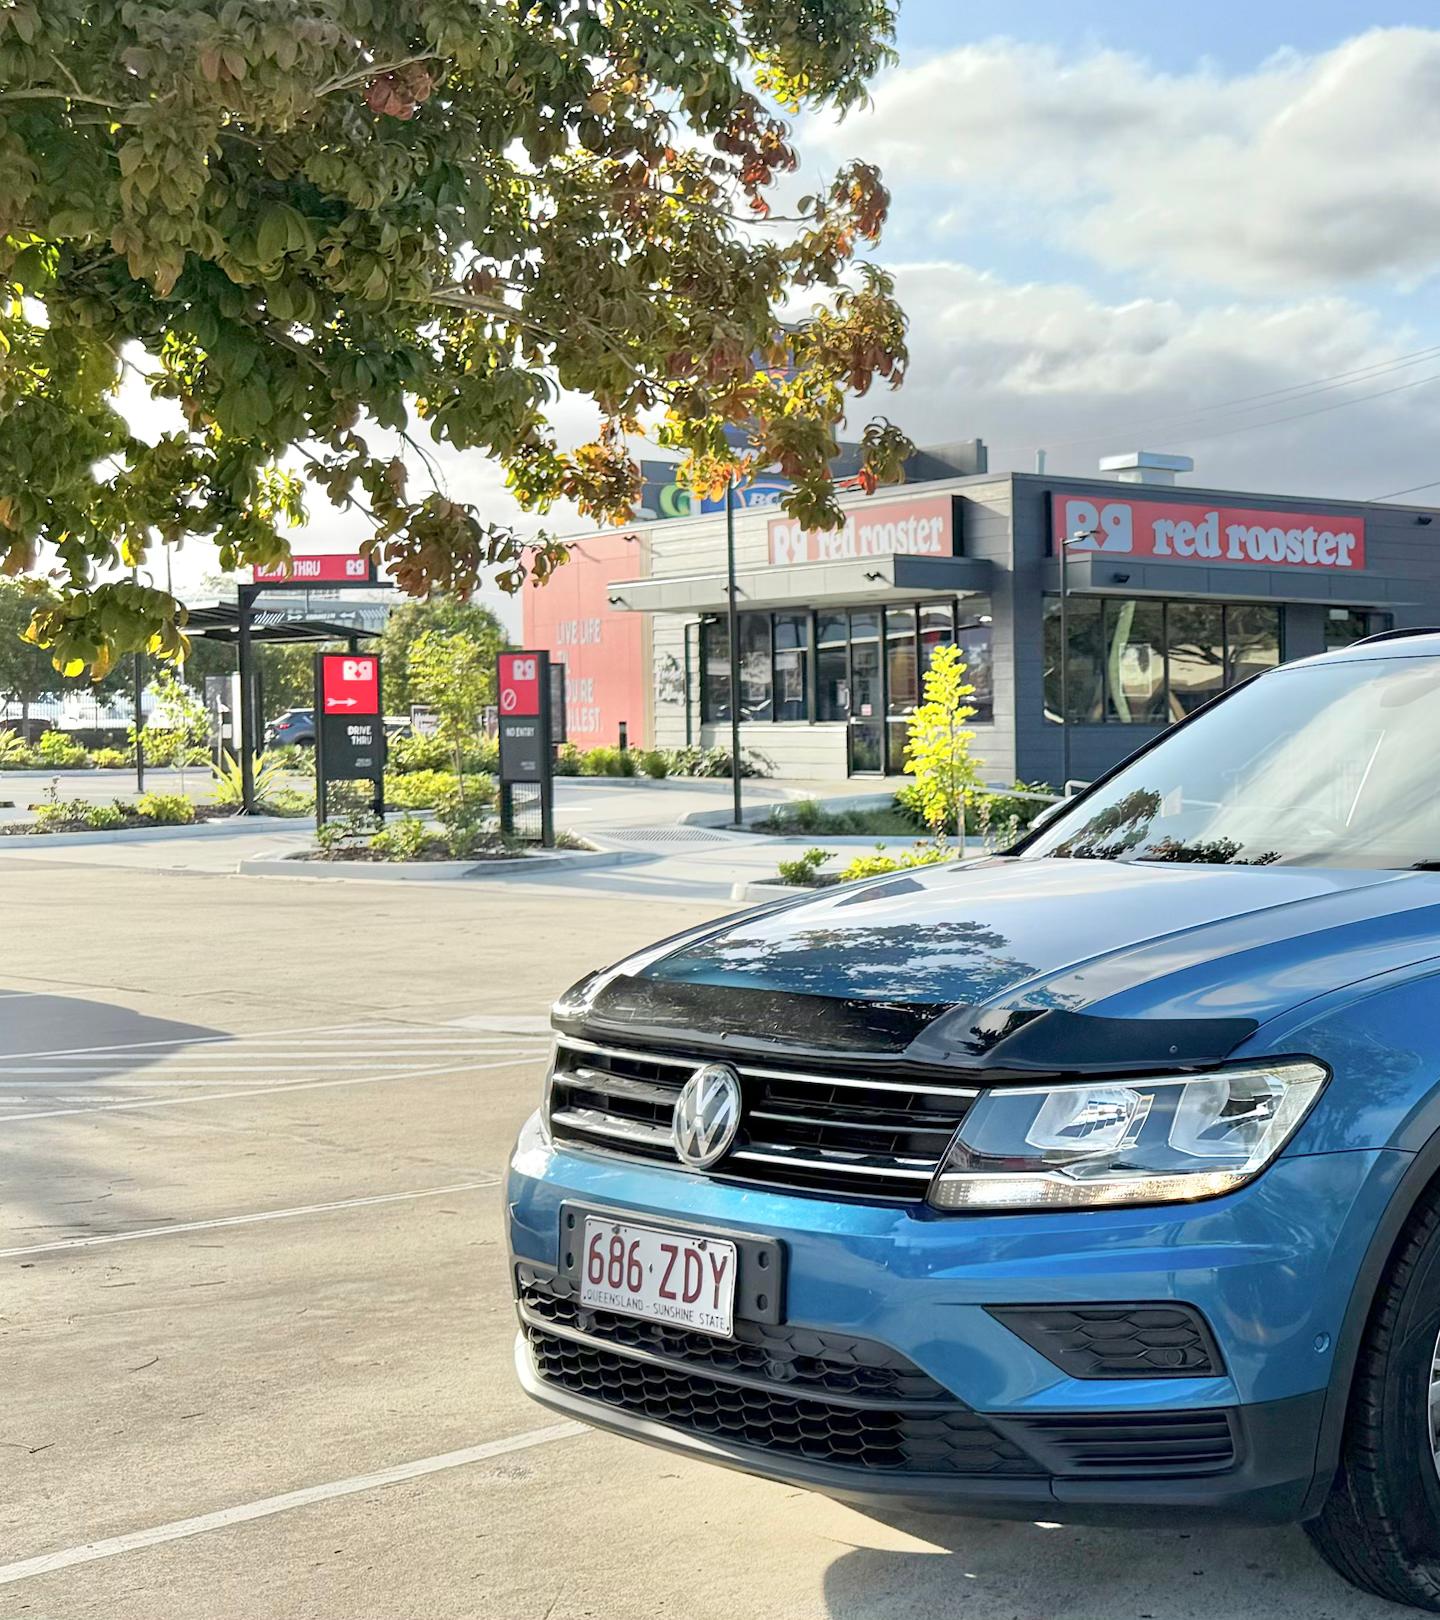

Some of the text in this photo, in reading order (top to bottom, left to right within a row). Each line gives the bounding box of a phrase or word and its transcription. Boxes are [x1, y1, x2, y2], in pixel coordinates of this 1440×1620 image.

[816, 516, 856, 560] red
[858, 513, 944, 556] rooster
[1152, 511, 1222, 557] red
[1225, 524, 1356, 567] rooster
[293, 560, 321, 577] THRU
[556, 618, 603, 646] LIVE LIFE
[346, 725, 372, 736] DRIVE
[350, 735, 373, 746] THRU
[516, 726, 535, 738] ENTRY
[588, 1232, 728, 1310] 686 ZDY
[586, 1289, 644, 1311] QUEENSLAND
[653, 1302, 695, 1323] SUNSHINE
[699, 1312, 726, 1331] STATE
